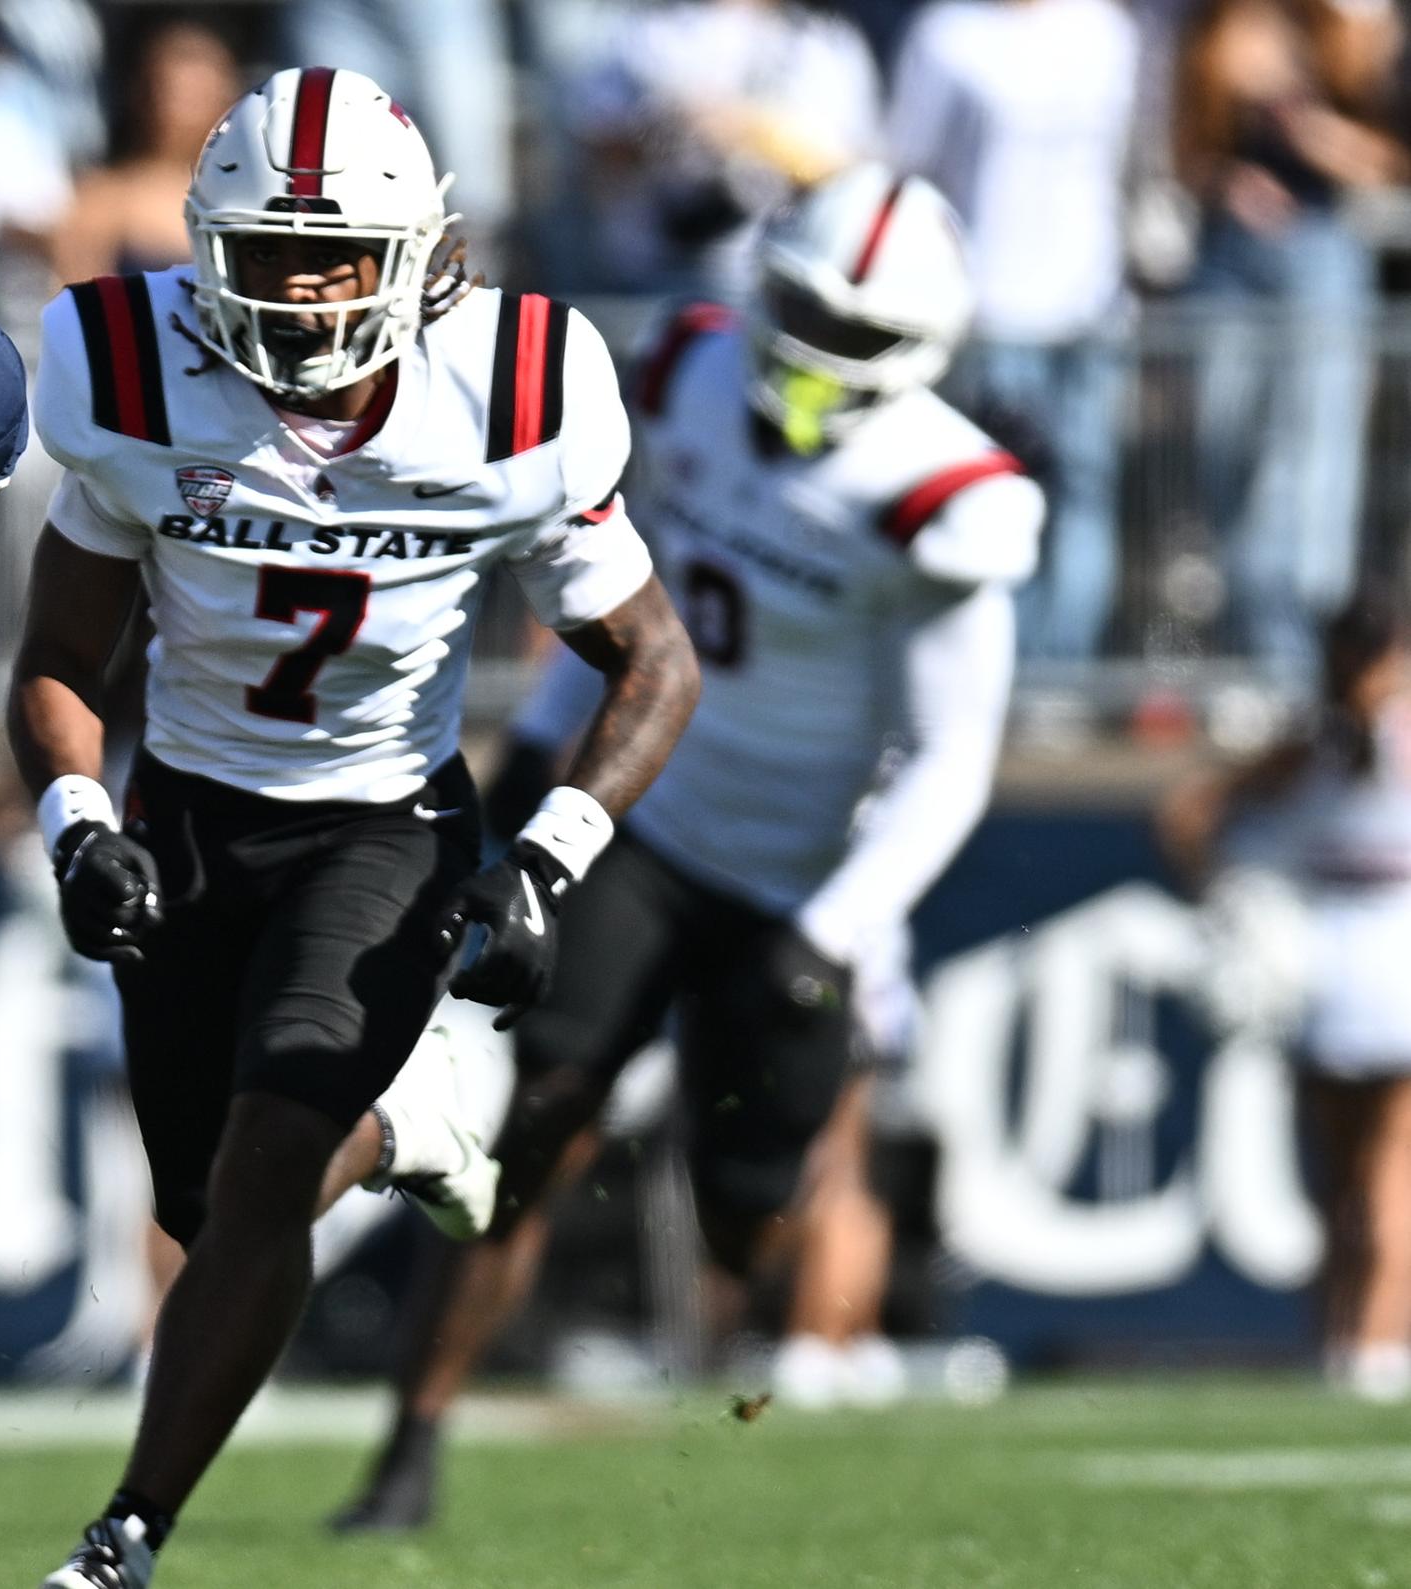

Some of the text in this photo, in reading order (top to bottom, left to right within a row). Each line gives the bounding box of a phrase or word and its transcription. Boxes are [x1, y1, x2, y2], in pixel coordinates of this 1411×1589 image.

[159, 514, 475, 560] BALL STATE
[244, 564, 372, 725] 7
